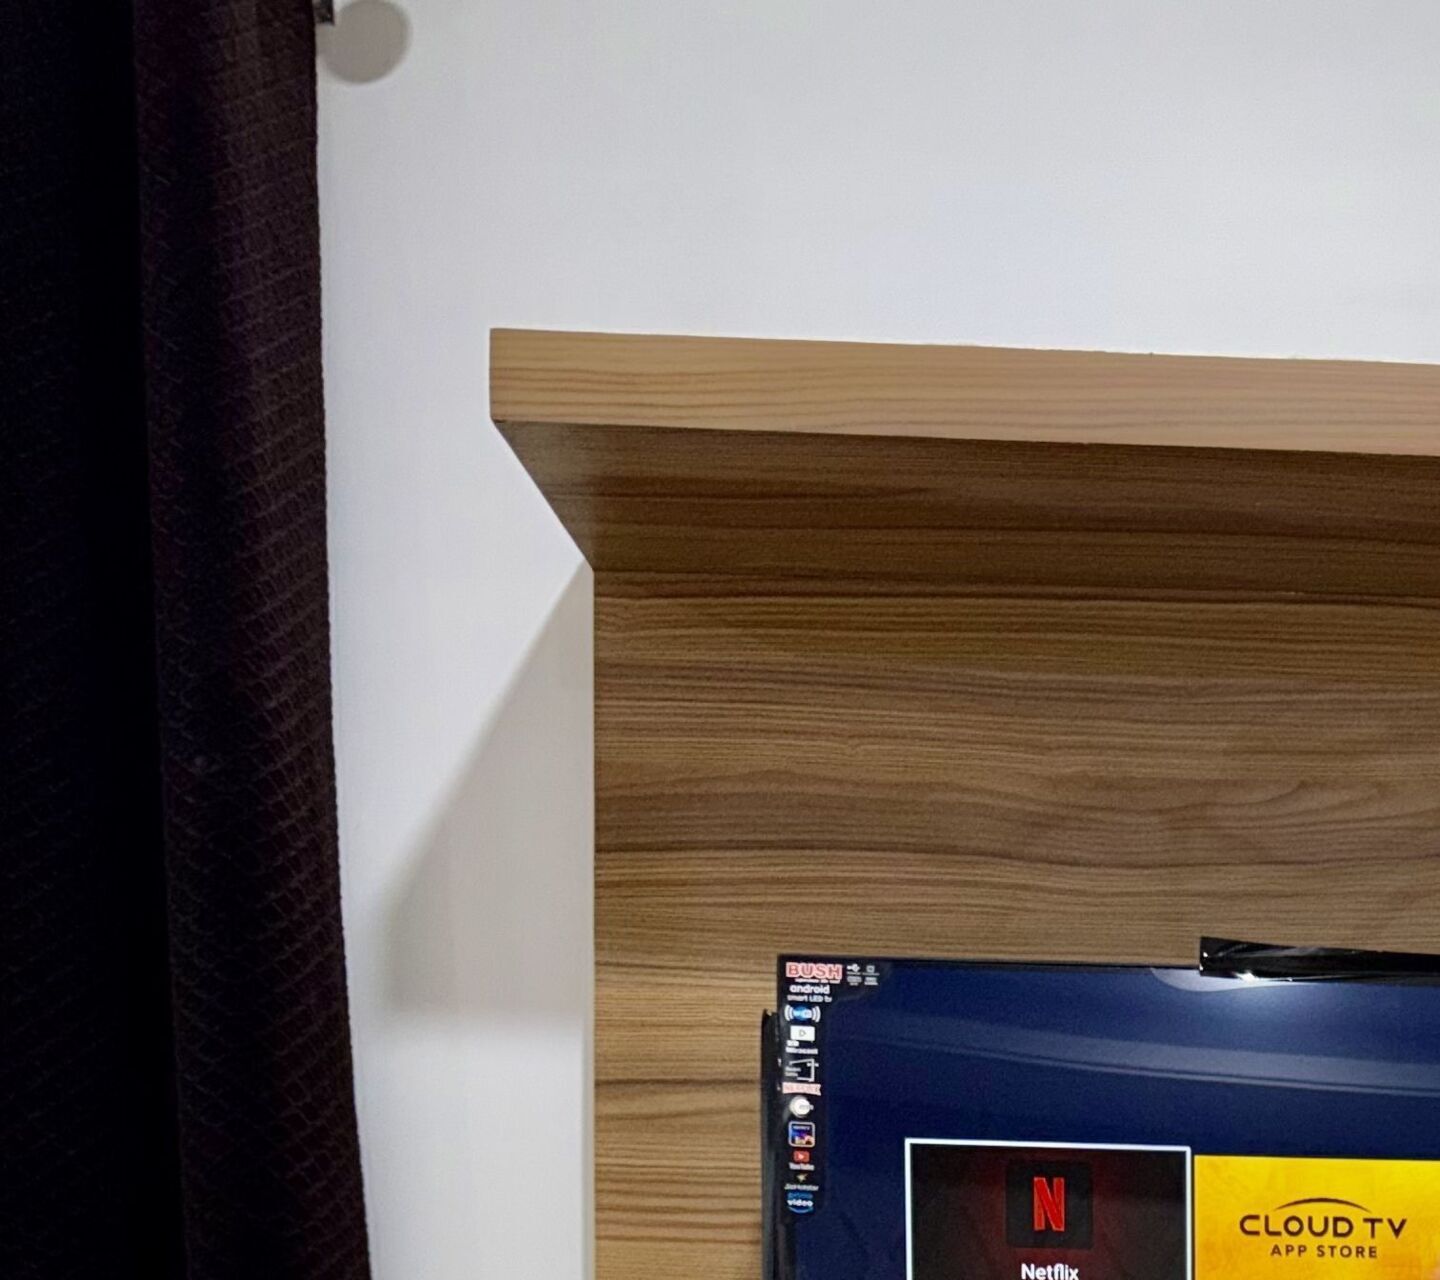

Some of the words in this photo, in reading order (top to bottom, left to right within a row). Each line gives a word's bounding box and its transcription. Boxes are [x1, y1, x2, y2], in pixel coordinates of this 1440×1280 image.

[786, 962, 843, 980] BUSH
[789, 984, 831, 994] android
[1033, 1176, 1066, 1232] N
[1239, 1213, 1354, 1240] CLOUD
[1366, 1217, 1409, 1240] TV
[1270, 1243, 1308, 1259] APP
[1315, 1243, 1379, 1260] STORE
